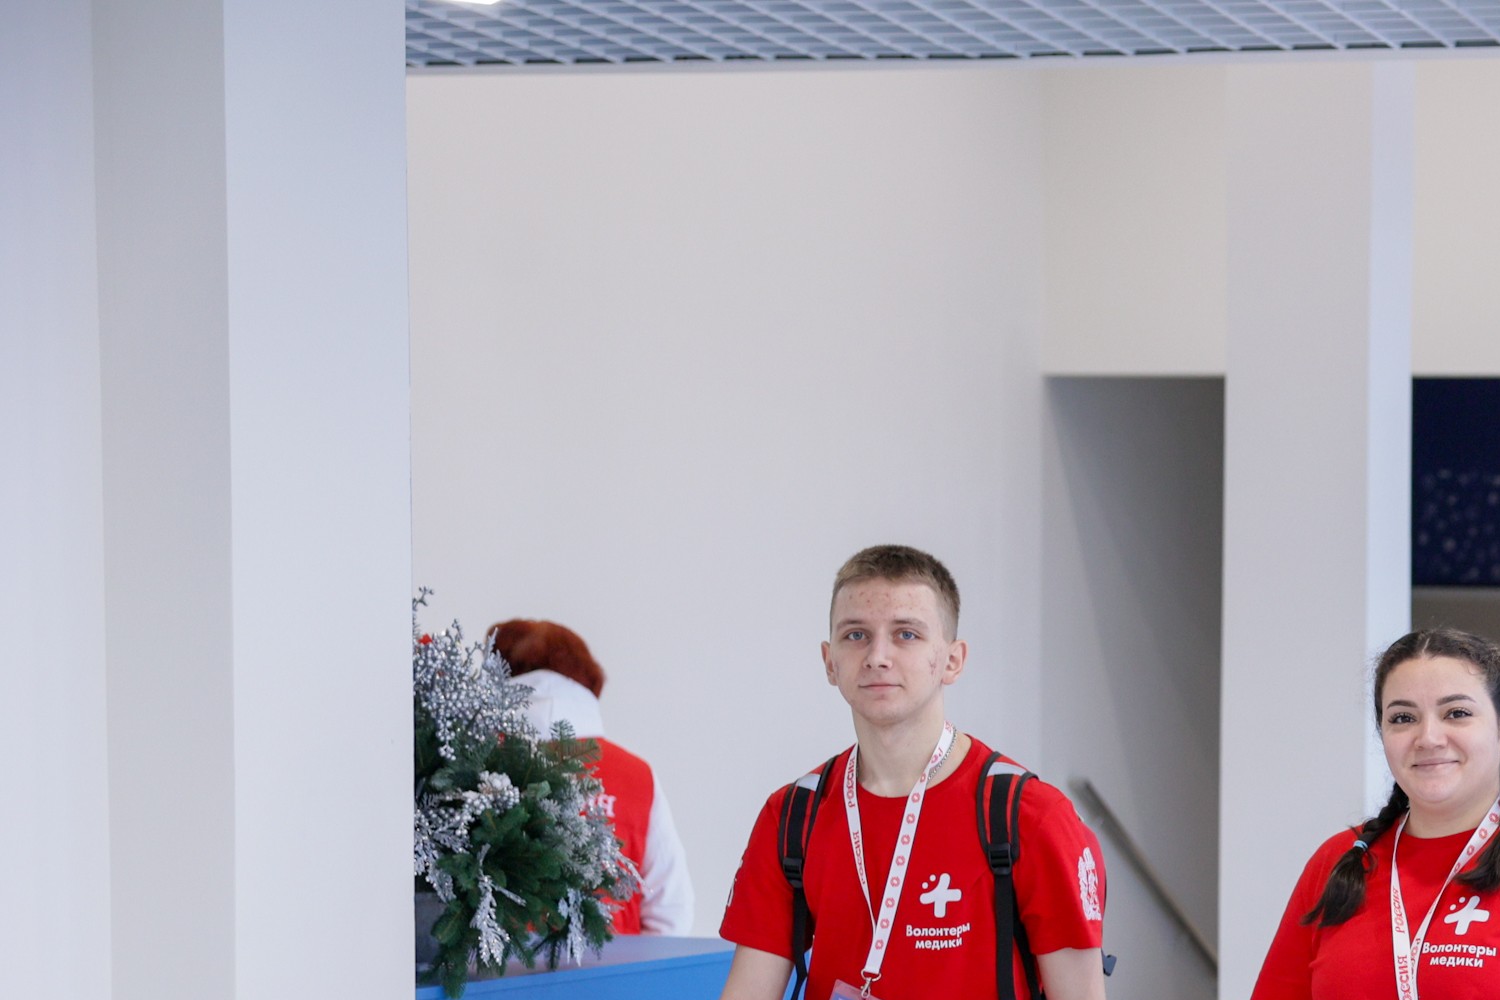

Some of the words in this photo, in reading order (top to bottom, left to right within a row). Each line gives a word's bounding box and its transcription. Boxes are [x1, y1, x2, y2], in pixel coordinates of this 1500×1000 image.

[905, 922, 971, 938] Волонтеры
[915, 937, 963, 951] медики
[1422, 942, 1497, 958] Волонтеры
[1429, 956, 1484, 968] медики
